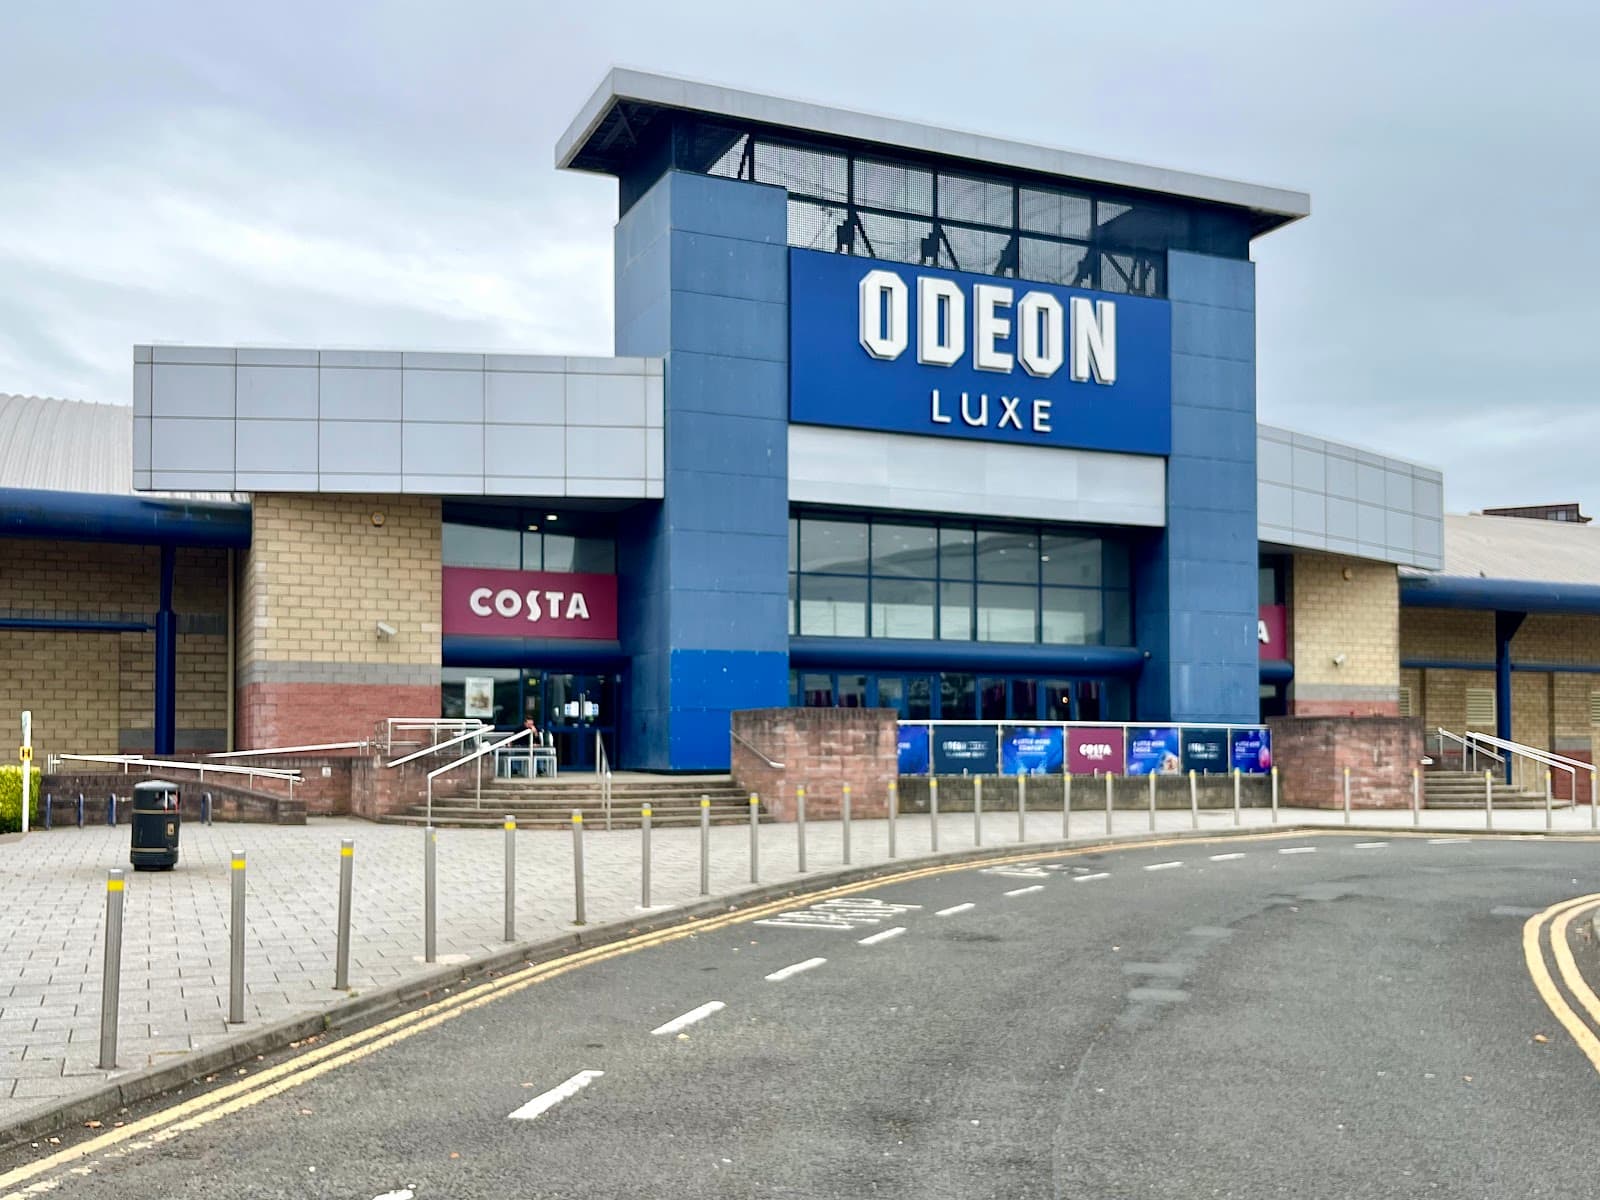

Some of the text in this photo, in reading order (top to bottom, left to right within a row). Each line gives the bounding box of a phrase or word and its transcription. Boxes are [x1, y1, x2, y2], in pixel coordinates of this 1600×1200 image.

[858, 269, 1117, 386] ODEON
[931, 389, 1053, 432] LUXE
[469, 587, 590, 621] COSTA
[1079, 744, 1112, 756] COSTA
